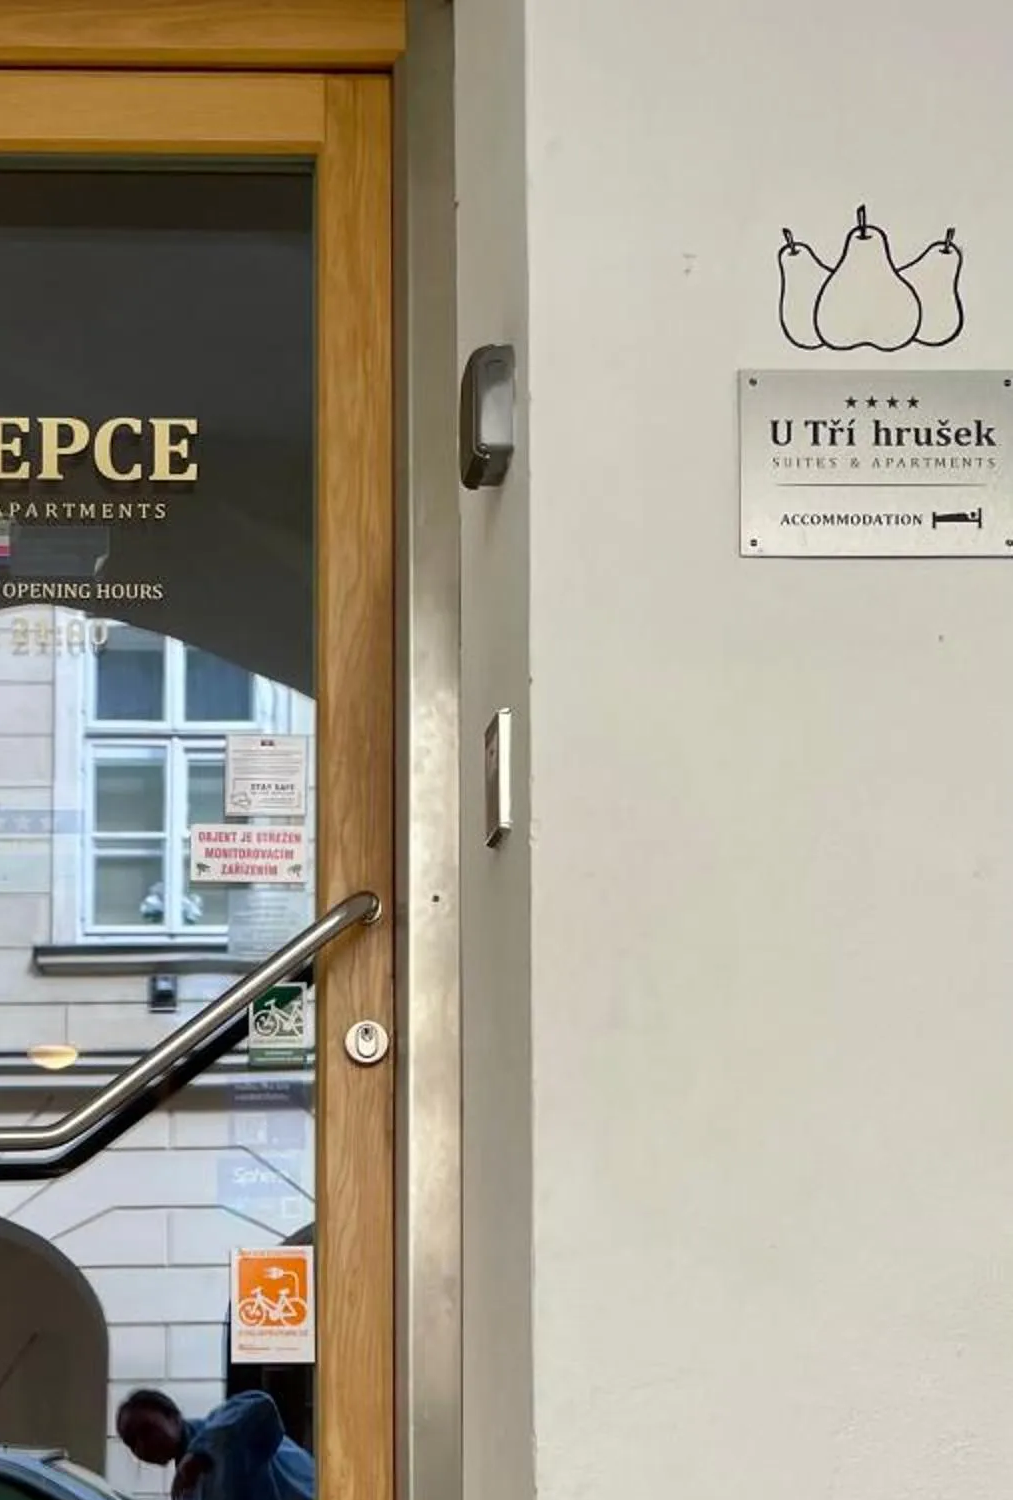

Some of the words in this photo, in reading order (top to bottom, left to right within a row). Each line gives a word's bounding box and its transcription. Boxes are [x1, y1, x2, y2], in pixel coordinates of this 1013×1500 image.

[770, 419, 793, 447] U
[804, 418, 856, 447] Tří
[872, 418, 997, 447] hrušek
[772, 457, 838, 469] SUITES
[849, 457, 861, 469] &
[871, 457, 996, 469] APARTMENTS
[780, 513, 923, 526] ACCOMMODATION
[2, 582, 91, 599] OPENING
[96, 583, 164, 599] HOURS
[240, 832, 252, 843] JE
